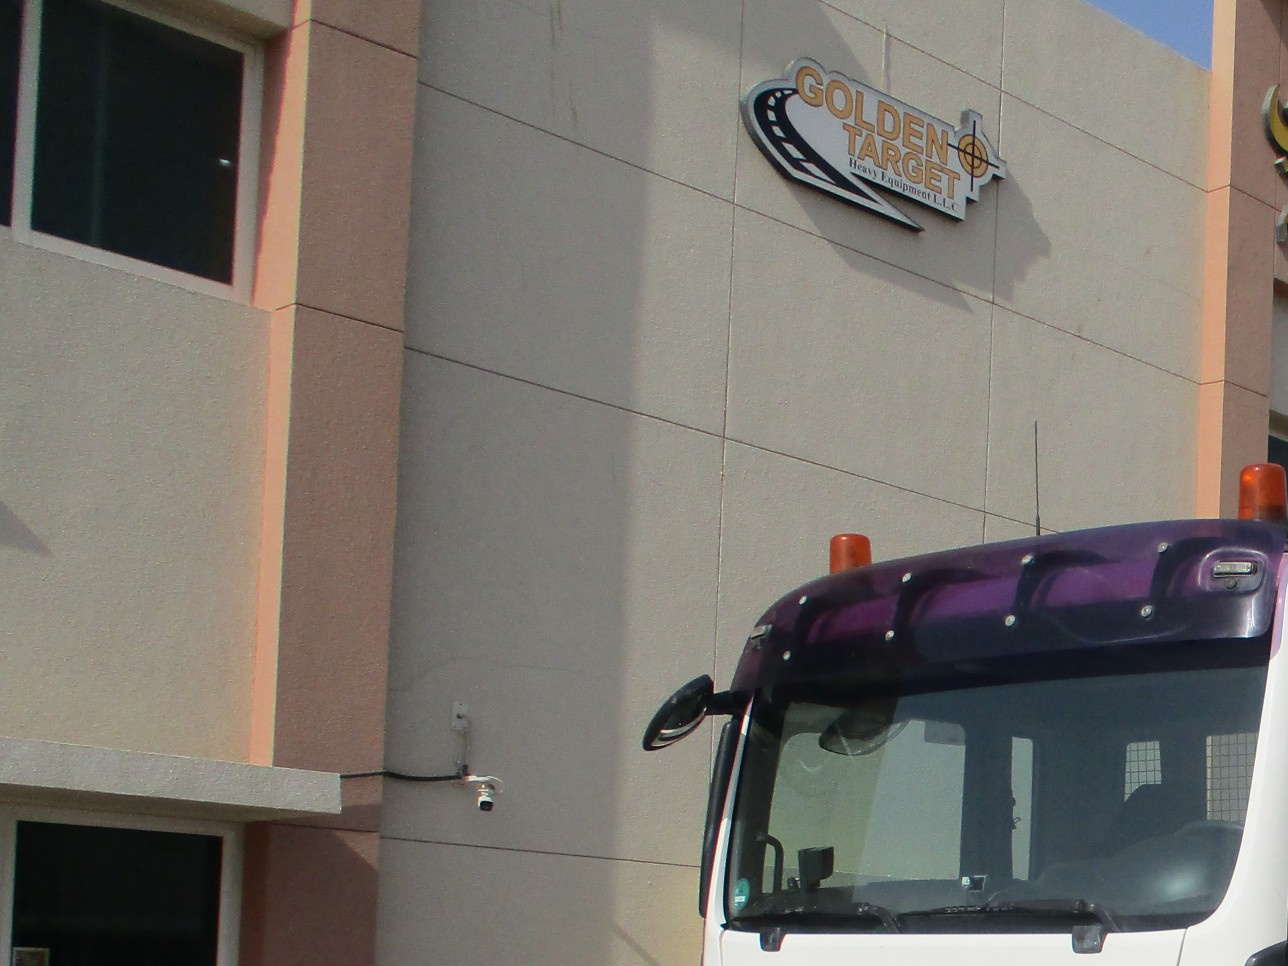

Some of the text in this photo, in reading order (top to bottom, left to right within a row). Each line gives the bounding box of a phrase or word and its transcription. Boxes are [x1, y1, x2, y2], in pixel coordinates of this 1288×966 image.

[795, 65, 949, 165] GOLDEN
[843, 122, 960, 200] TARGET
[849, 157, 877, 180] Heavy
[881, 172, 931, 203] Equipment
